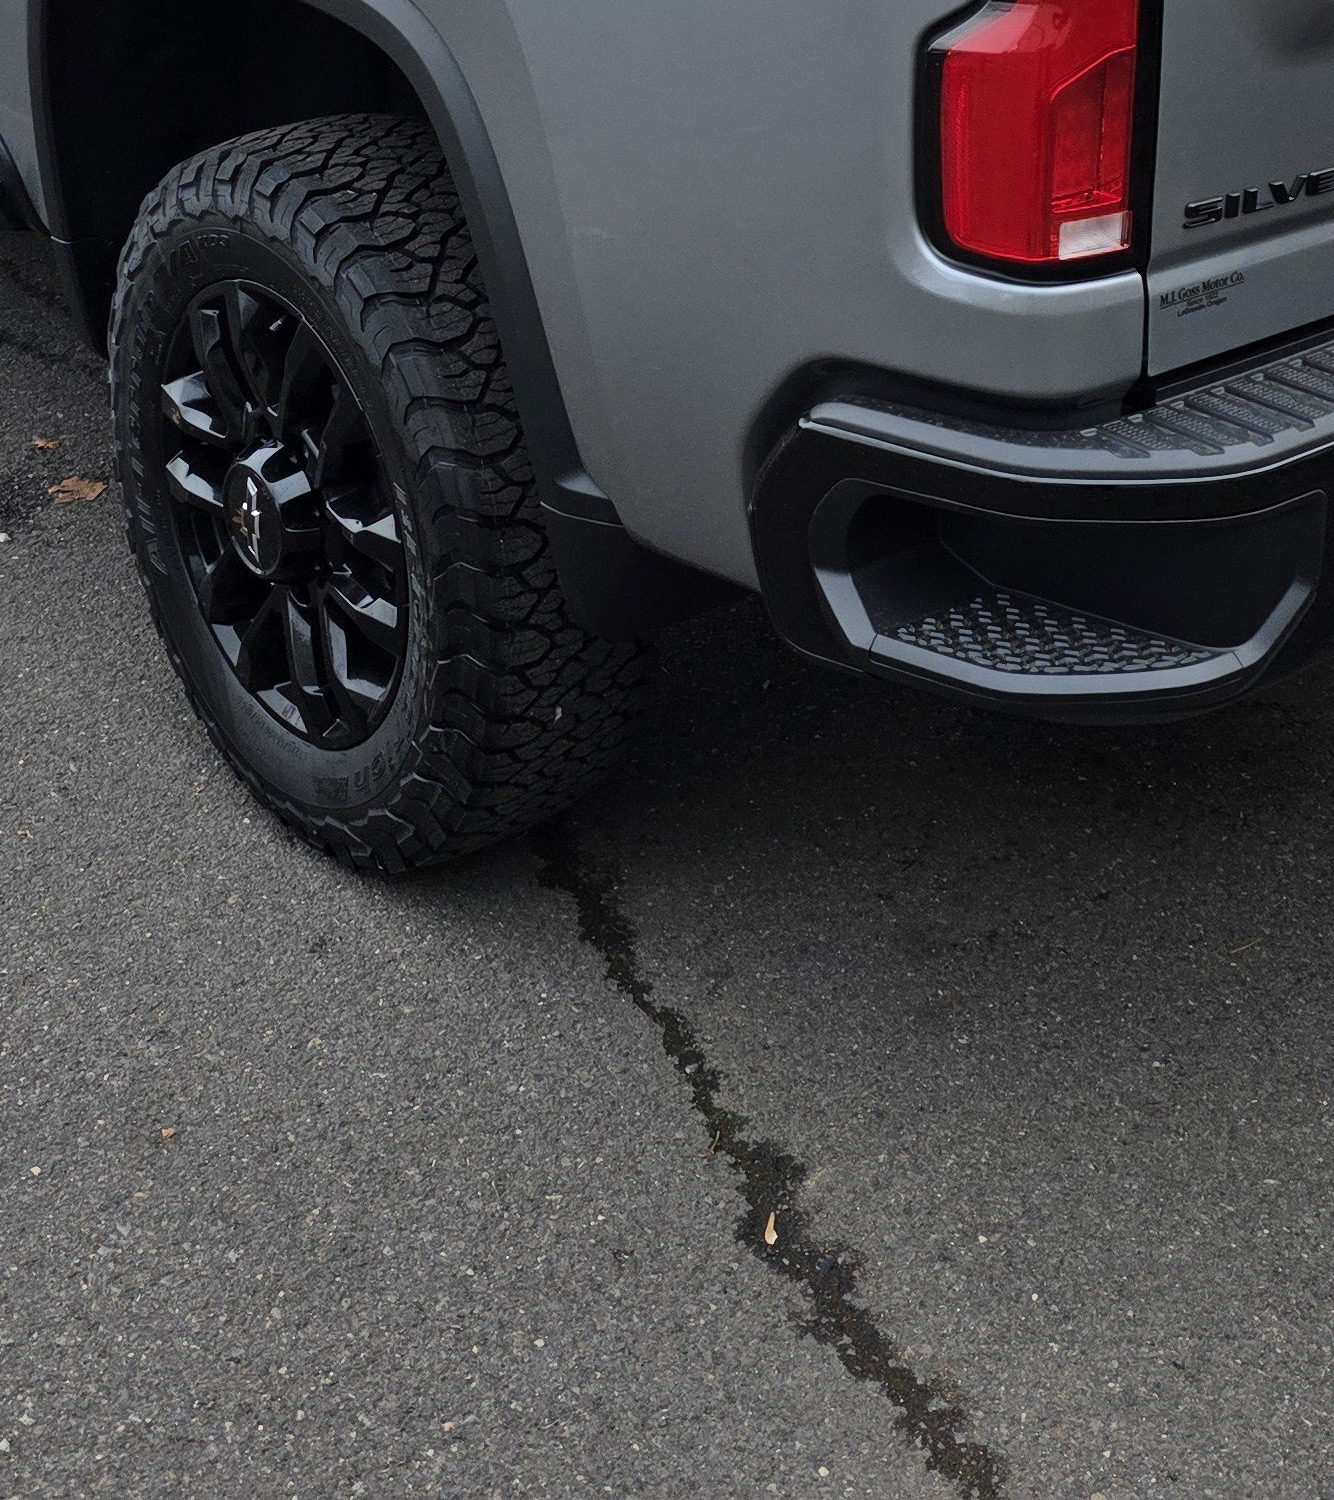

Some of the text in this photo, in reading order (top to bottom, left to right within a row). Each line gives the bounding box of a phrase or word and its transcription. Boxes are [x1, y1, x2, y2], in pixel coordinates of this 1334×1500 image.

[1178, 286, 1200, 300] Goss
[1202, 277, 1229, 291] Motor
[1230, 271, 1245, 283] Co.
